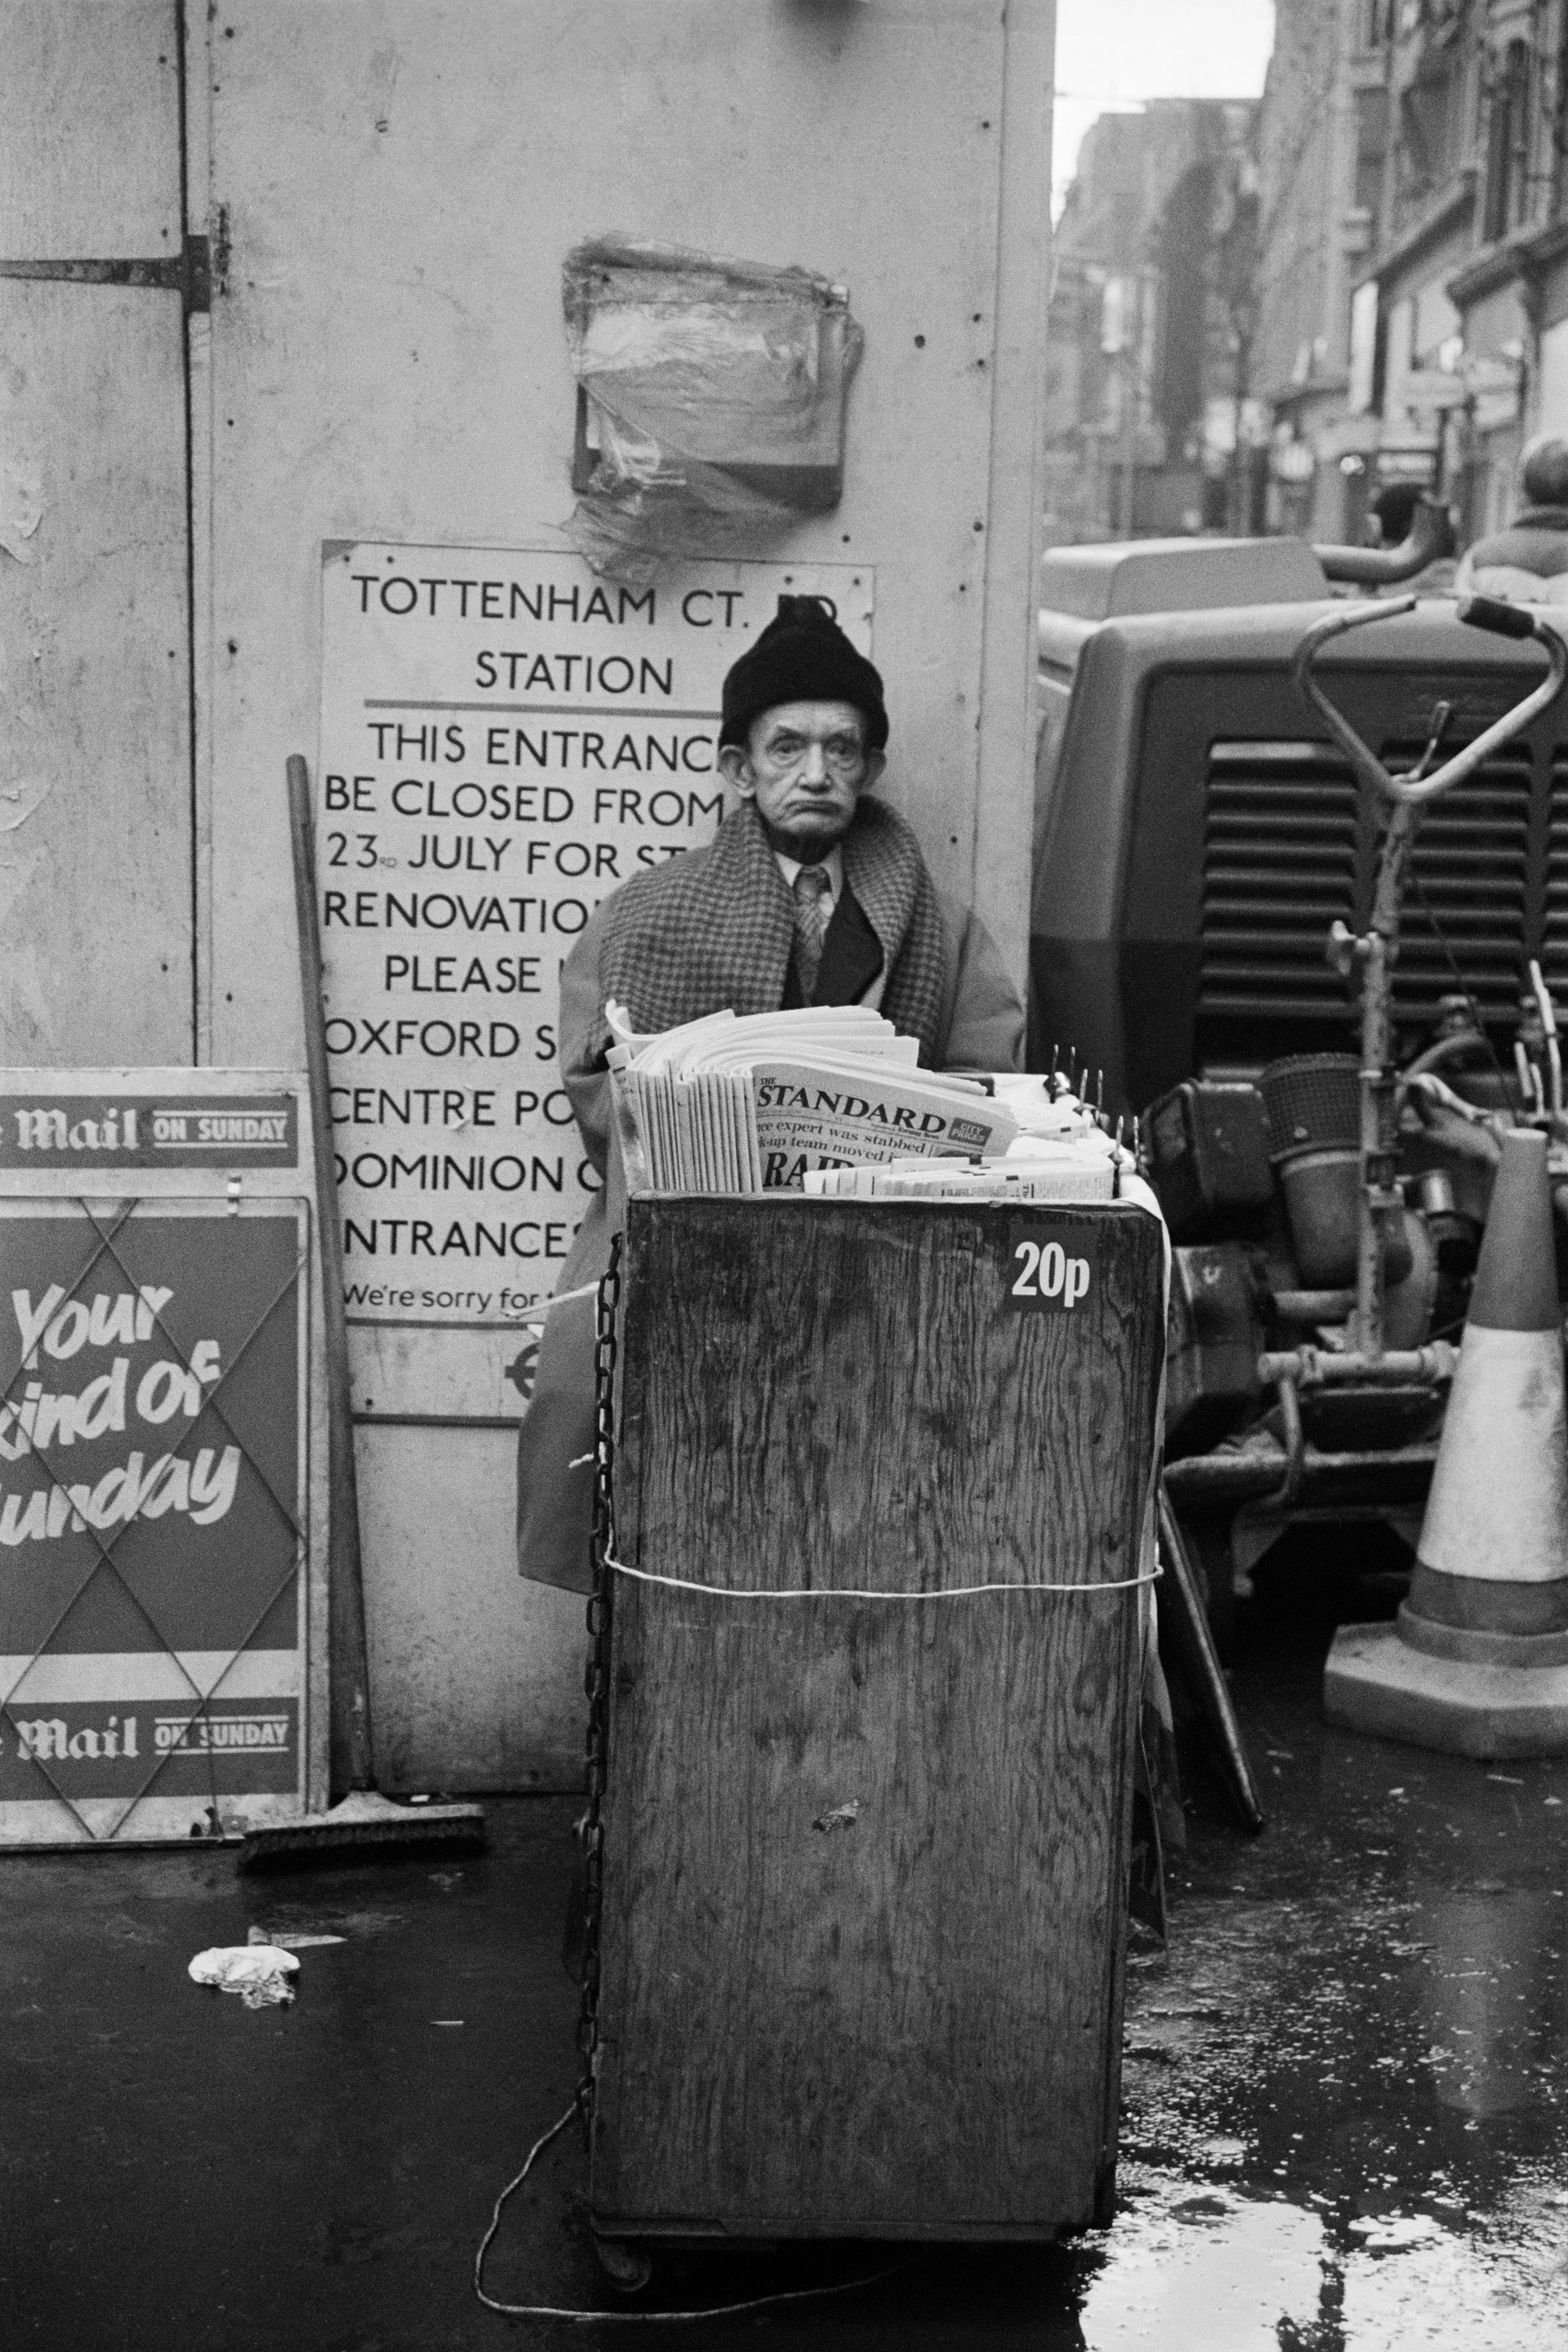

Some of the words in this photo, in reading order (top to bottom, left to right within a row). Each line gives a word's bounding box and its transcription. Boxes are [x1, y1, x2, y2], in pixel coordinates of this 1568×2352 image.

[351, 575, 655, 625] TOTTENHAM
[682, 590, 748, 627] CT.
[476, 650, 672, 695] STATION
[367, 723, 465, 763] THIS
[487, 728, 720, 772] ENTRANC
[325, 775, 376, 811] BE
[392, 779, 573, 822] CLOSED
[595, 789, 724, 826] FROM
[408, 834, 511, 871] JULY
[527, 840, 621, 878] FOR
[324, 891, 598, 935] RENOVATIO
[386, 955, 541, 993] PLEASE
[325, 1018, 521, 1058] OXFORD
[13, 1108, 140, 1150] Mail
[154, 1118, 187, 1140] ON
[198, 1118, 288, 1140] SUNDAY
[331, 1087, 495, 1127] CENTRE
[515, 1090, 577, 1126] PO
[757, 1085, 946, 1133] STANDARD
[776, 1122, 823, 1135] expert
[829, 1128, 858, 1142] was
[865, 1136, 926, 1154] stabbed
[790, 1137, 828, 1150] team
[833, 1143, 884, 1162] moved
[344, 1219, 582, 1258] NTRANCE
[1011, 1241, 1091, 1308] 20p
[343, 1284, 415, 1307] We're
[422, 1290, 492, 1314] sorry
[500, 1287, 540, 1309] for
[12, 1283, 174, 1370] Your
[136, 1340, 222, 1425] of
[0, 1445, 242, 1547] unday
[16, 1715, 140, 1760] Mail
[154, 1725, 187, 1747] ON
[199, 1723, 289, 1747] SUNDAY
